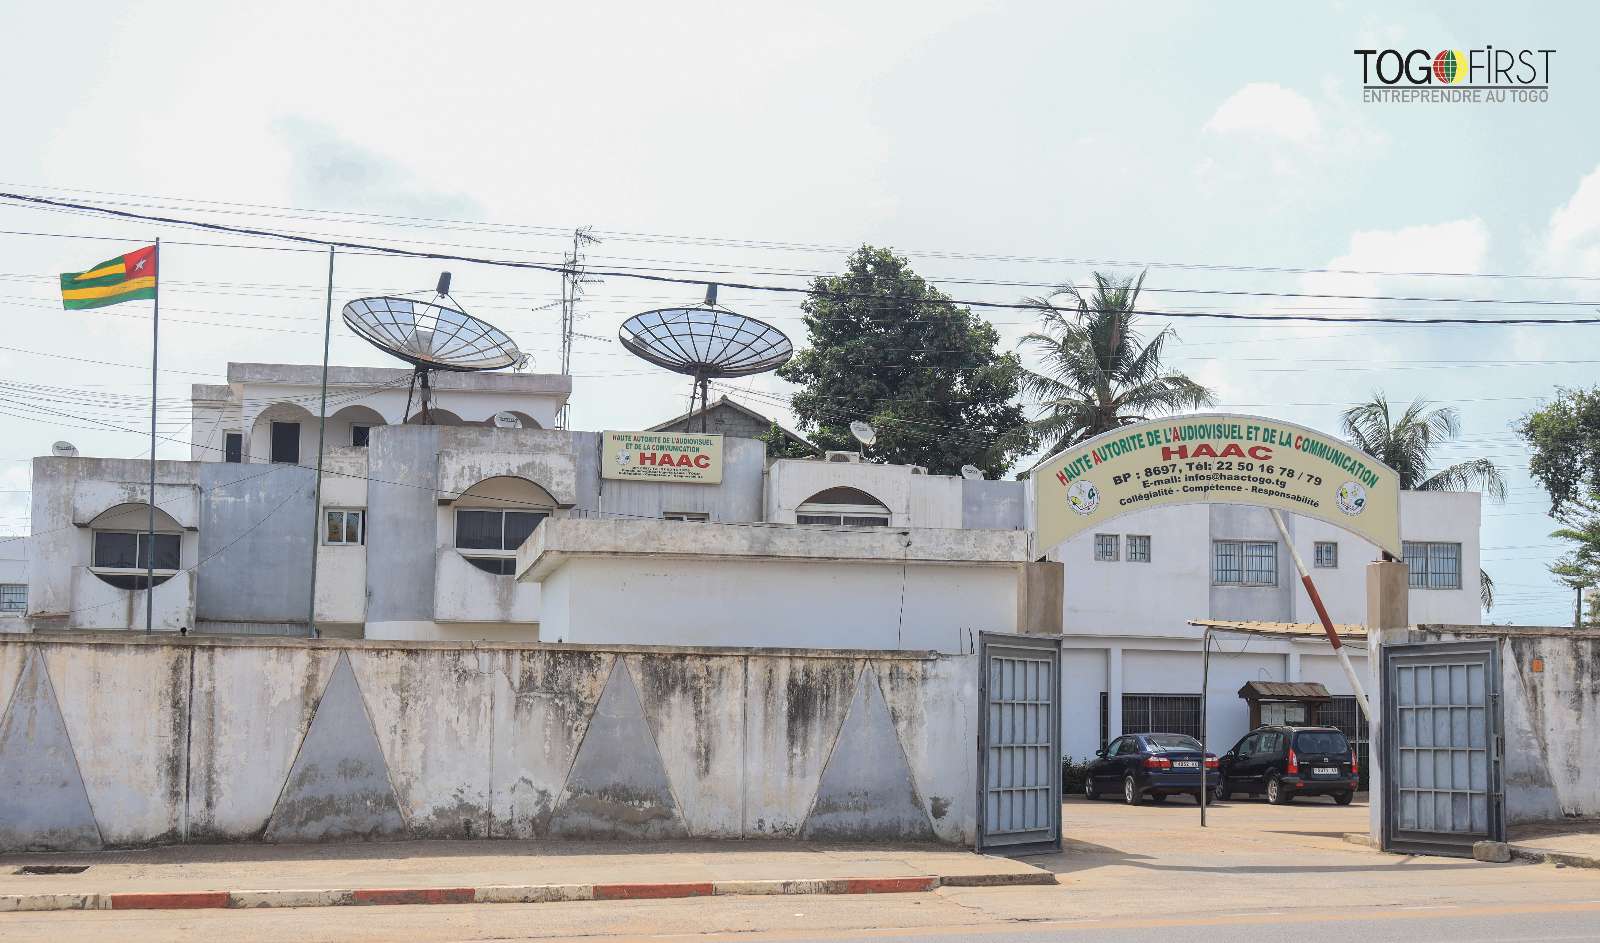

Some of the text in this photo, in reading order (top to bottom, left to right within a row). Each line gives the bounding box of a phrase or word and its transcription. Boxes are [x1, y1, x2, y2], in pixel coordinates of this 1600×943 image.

[612, 434, 632, 442] HAUTE
[663, 436, 671, 444] DE
[640, 452, 711, 469] HAAC
[1056, 424, 1380, 489] HAUTE AUTORITE DE L'AUDIOVISUEL ET DE LA COMMUNICATION
[1162, 443, 1273, 462] HAAC
[1112, 472, 1131, 486] BP
[1216, 461, 1233, 471] 22
[1237, 462, 1254, 471] 50
[1258, 463, 1274, 474] 16
[1279, 466, 1295, 478] 78
[1306, 473, 1322, 486] 79
